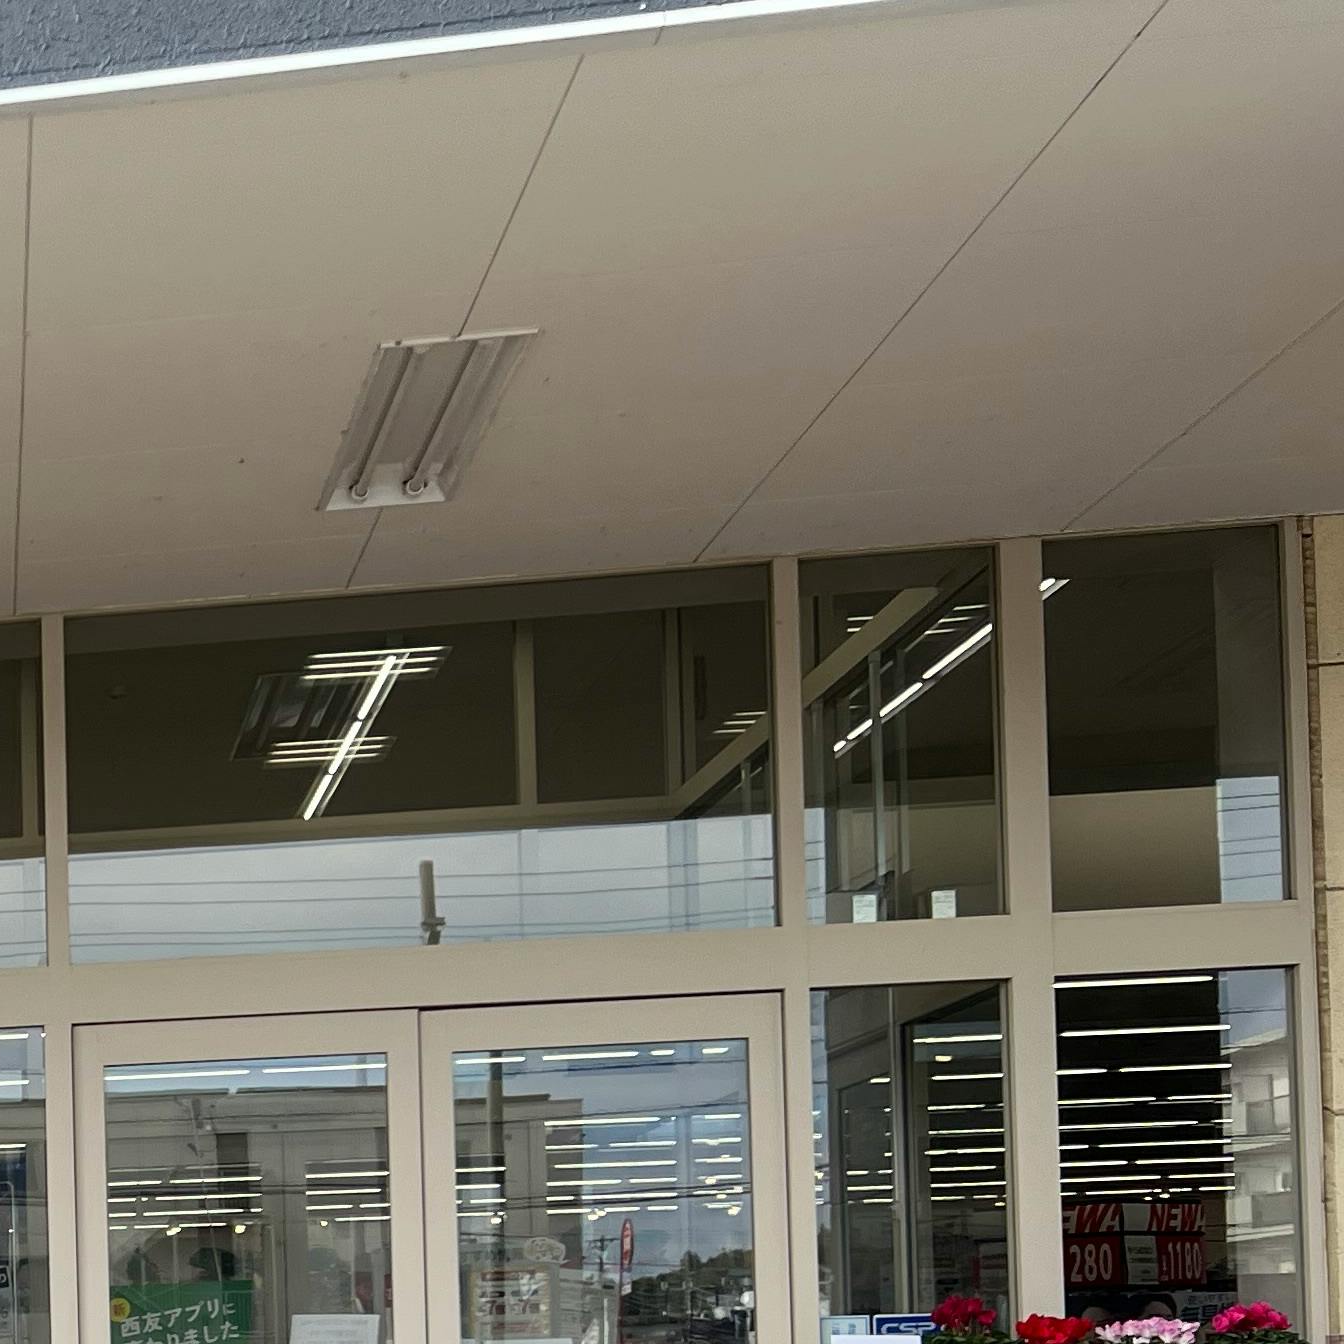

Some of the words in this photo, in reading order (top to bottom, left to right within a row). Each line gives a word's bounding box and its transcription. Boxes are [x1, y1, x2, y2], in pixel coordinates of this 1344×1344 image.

[120, 1297, 237, 1338] 西友アプリに
